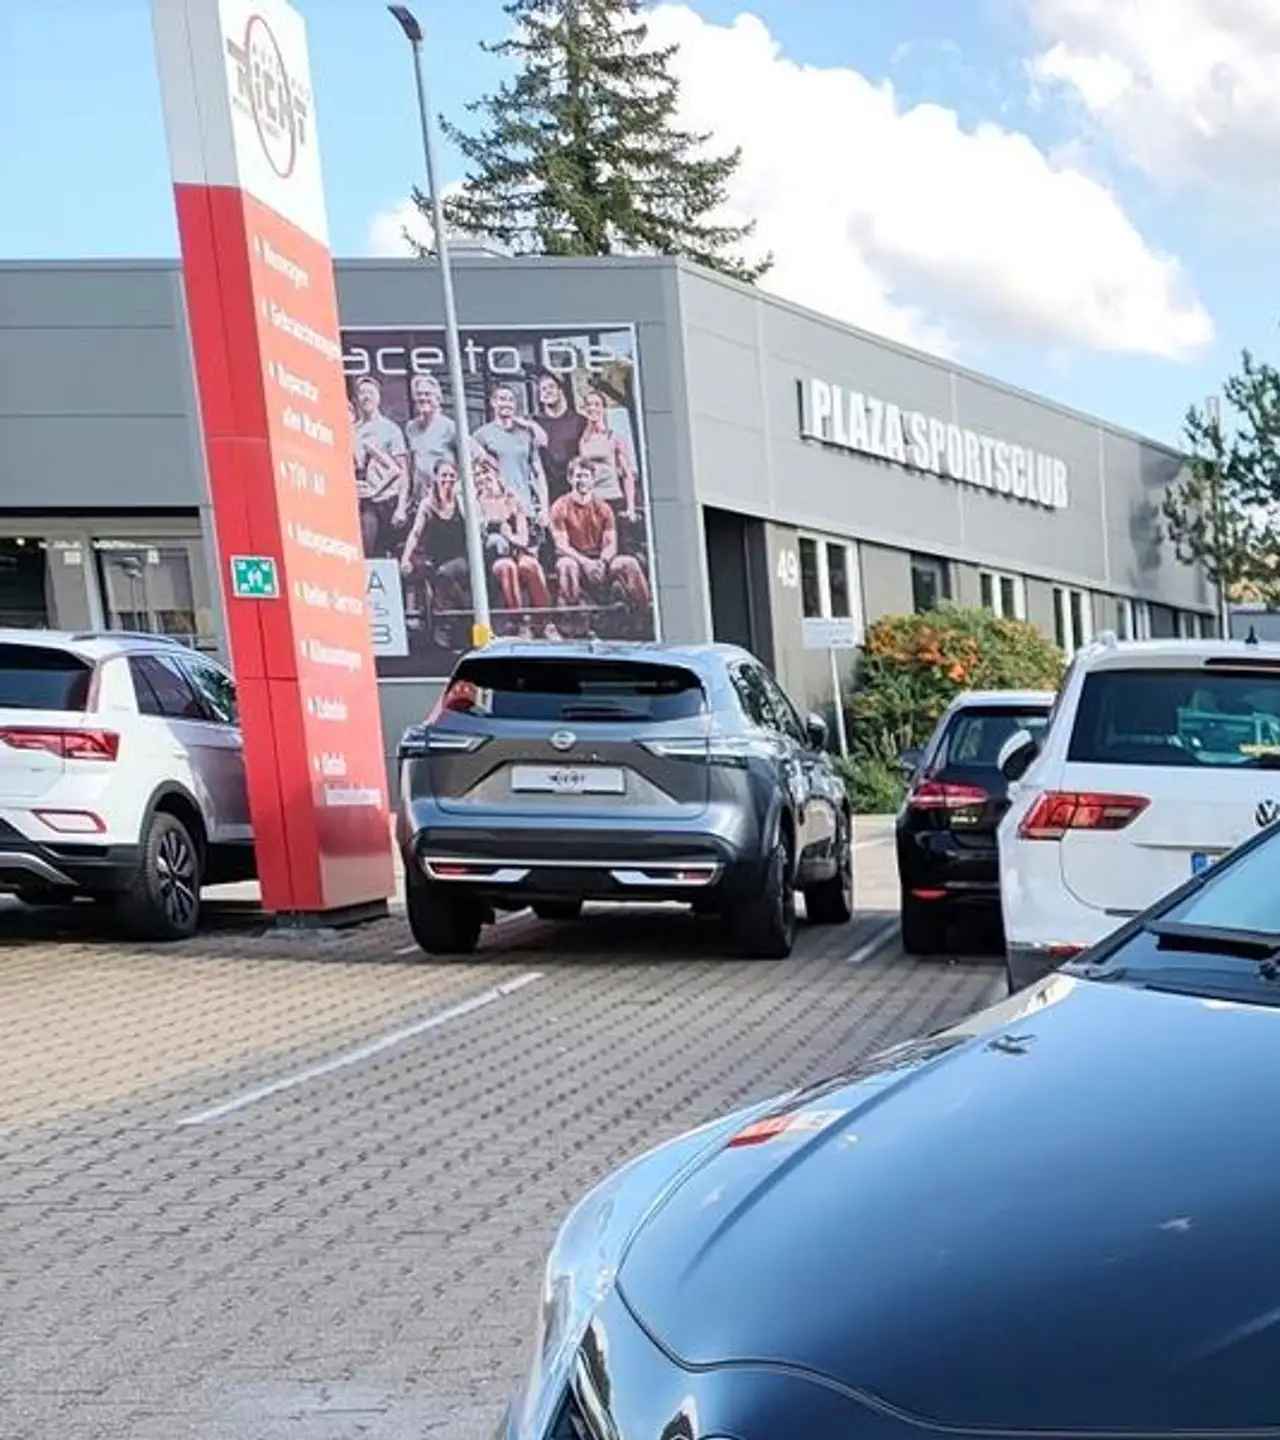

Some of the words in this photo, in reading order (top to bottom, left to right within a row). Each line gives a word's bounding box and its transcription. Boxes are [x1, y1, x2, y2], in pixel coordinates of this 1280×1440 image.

[464, 339, 522, 375] to
[542, 338, 617, 375] be
[810, 378, 906, 464] PLAZA
[905, 410, 1068, 508] SPORTSCLUB
[778, 548, 798, 589] 49
